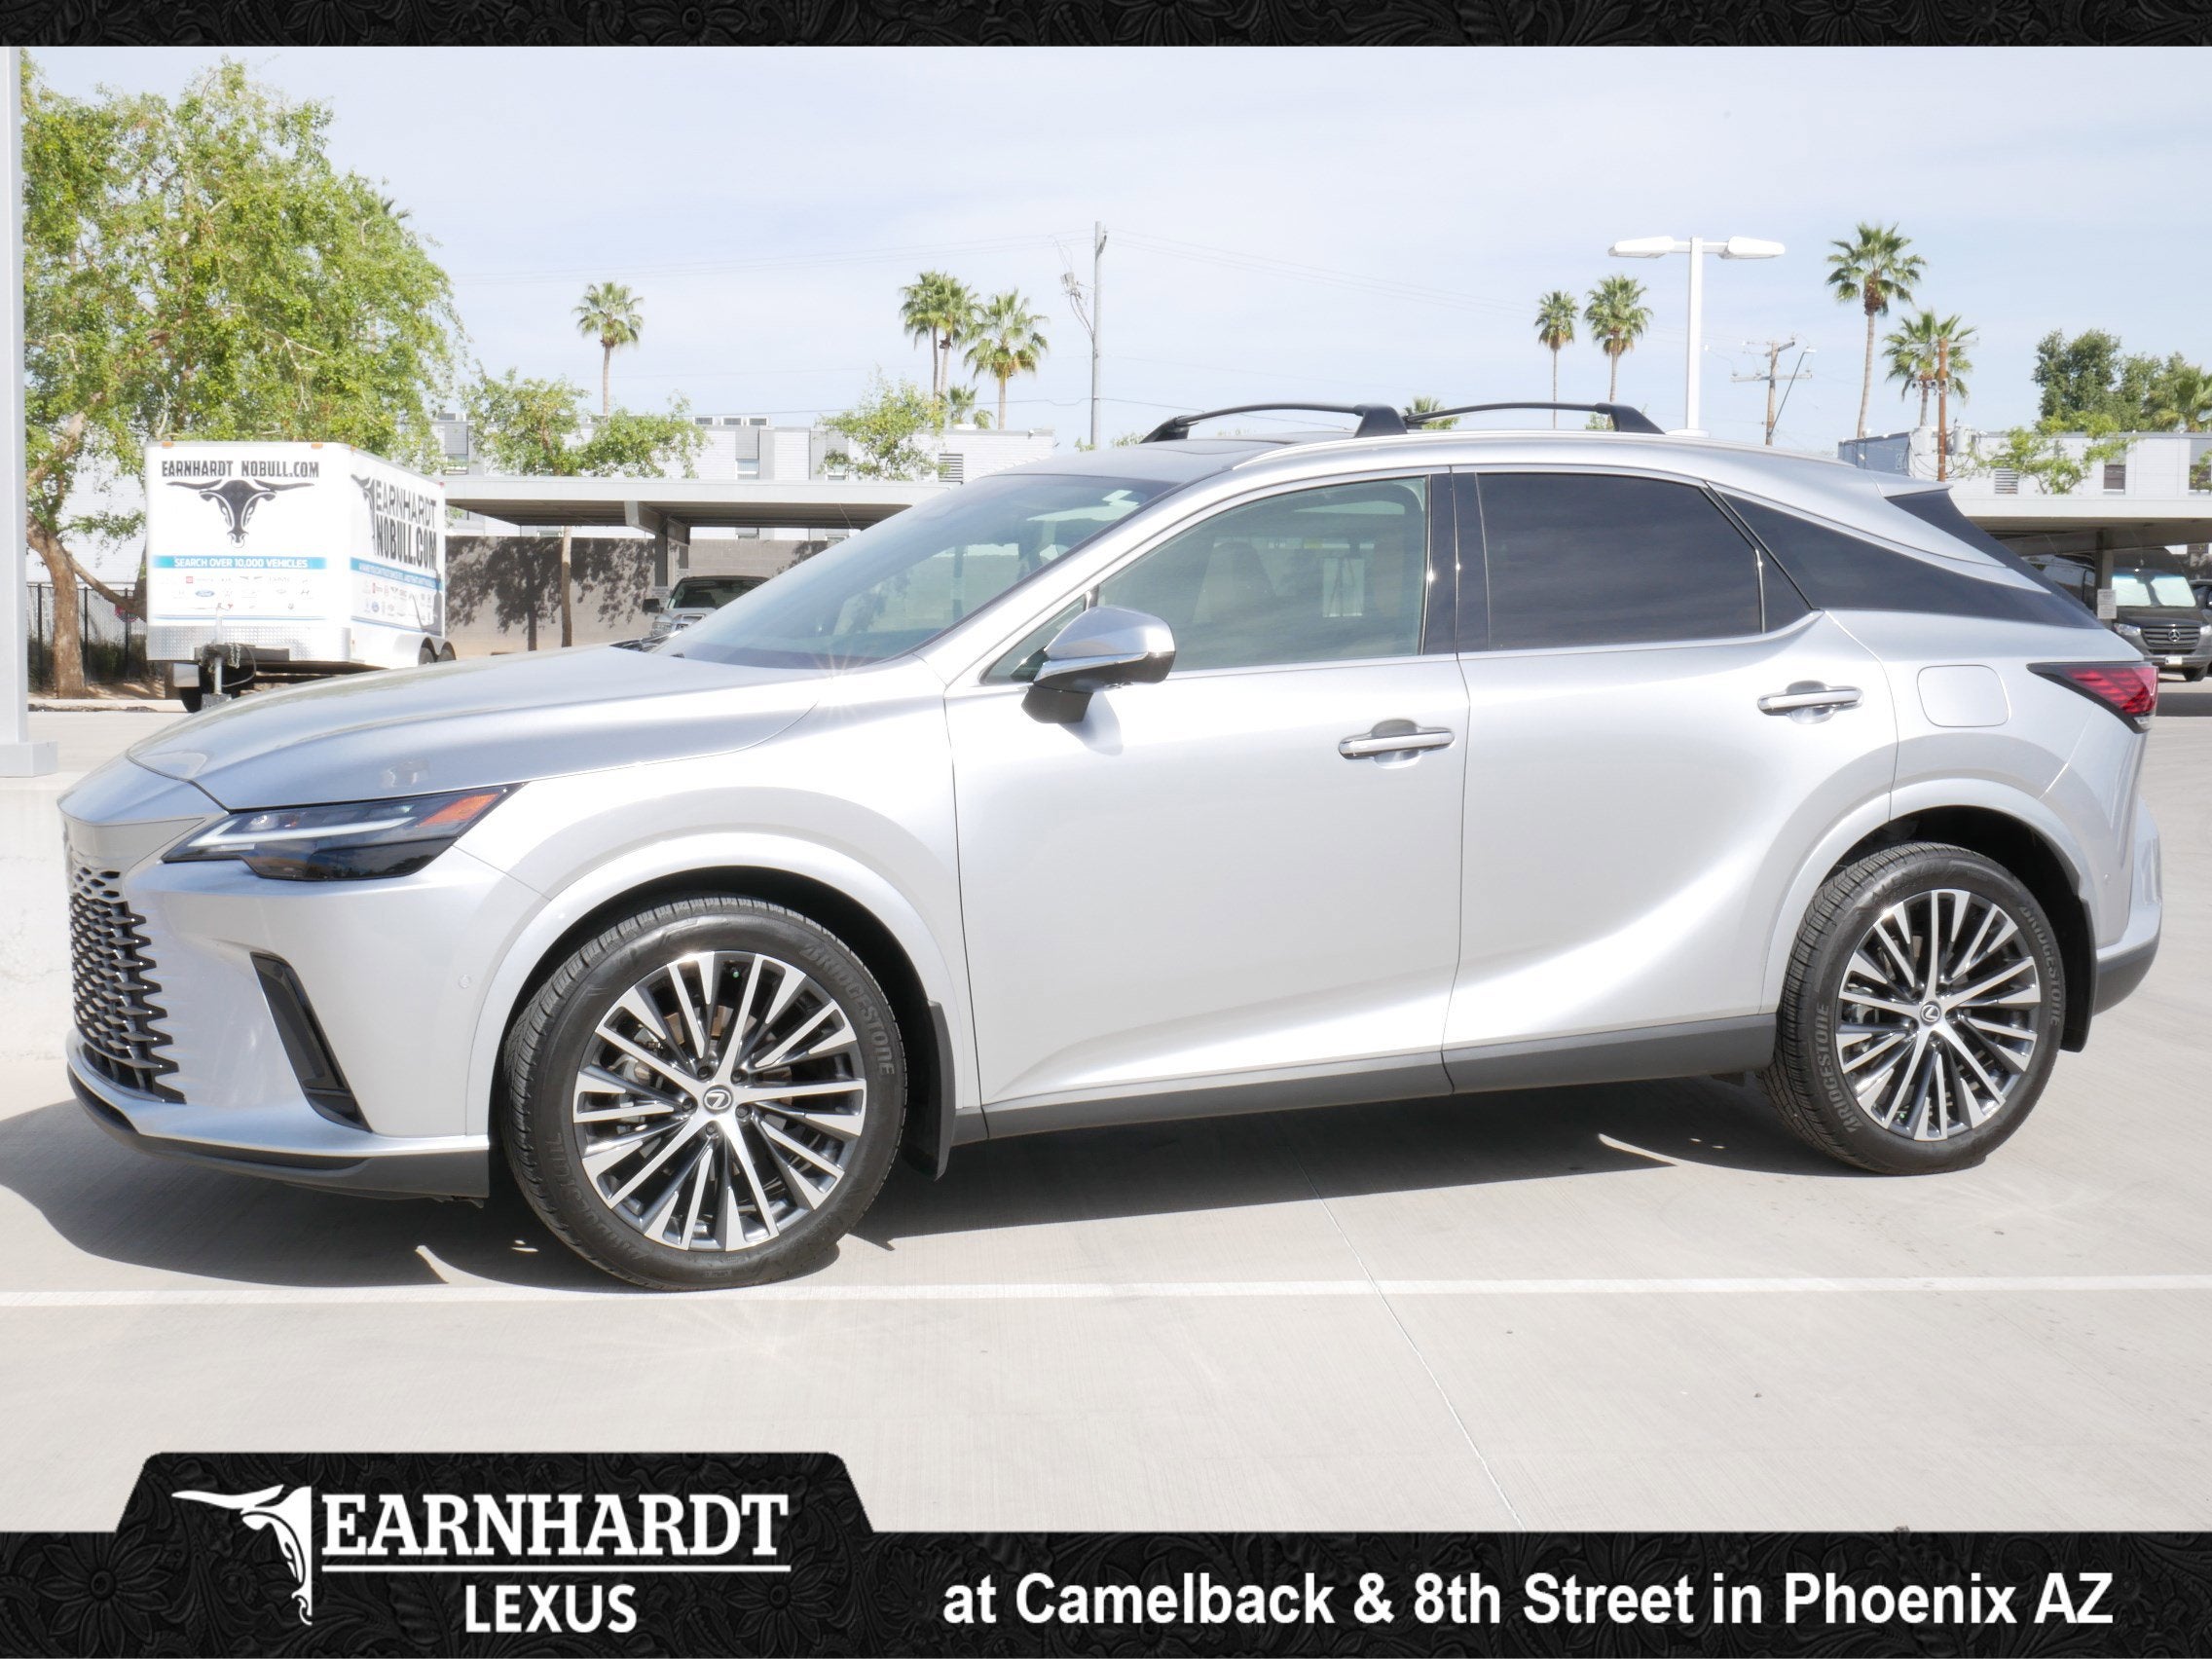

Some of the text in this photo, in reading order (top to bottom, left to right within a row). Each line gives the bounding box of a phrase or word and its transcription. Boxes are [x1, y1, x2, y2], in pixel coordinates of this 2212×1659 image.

[162, 460, 319, 478] EARNHARDT NOBULL.COM
[376, 479, 437, 530] EARNHARDT
[174, 558, 308, 569] SEARCH OVER 10,000 VEHICLES
[376, 514, 437, 570] NOBULL.COM
[798, 942, 895, 1075] BRIDGESTONE
[1815, 1003, 1863, 1133] BRIDGESTONE
